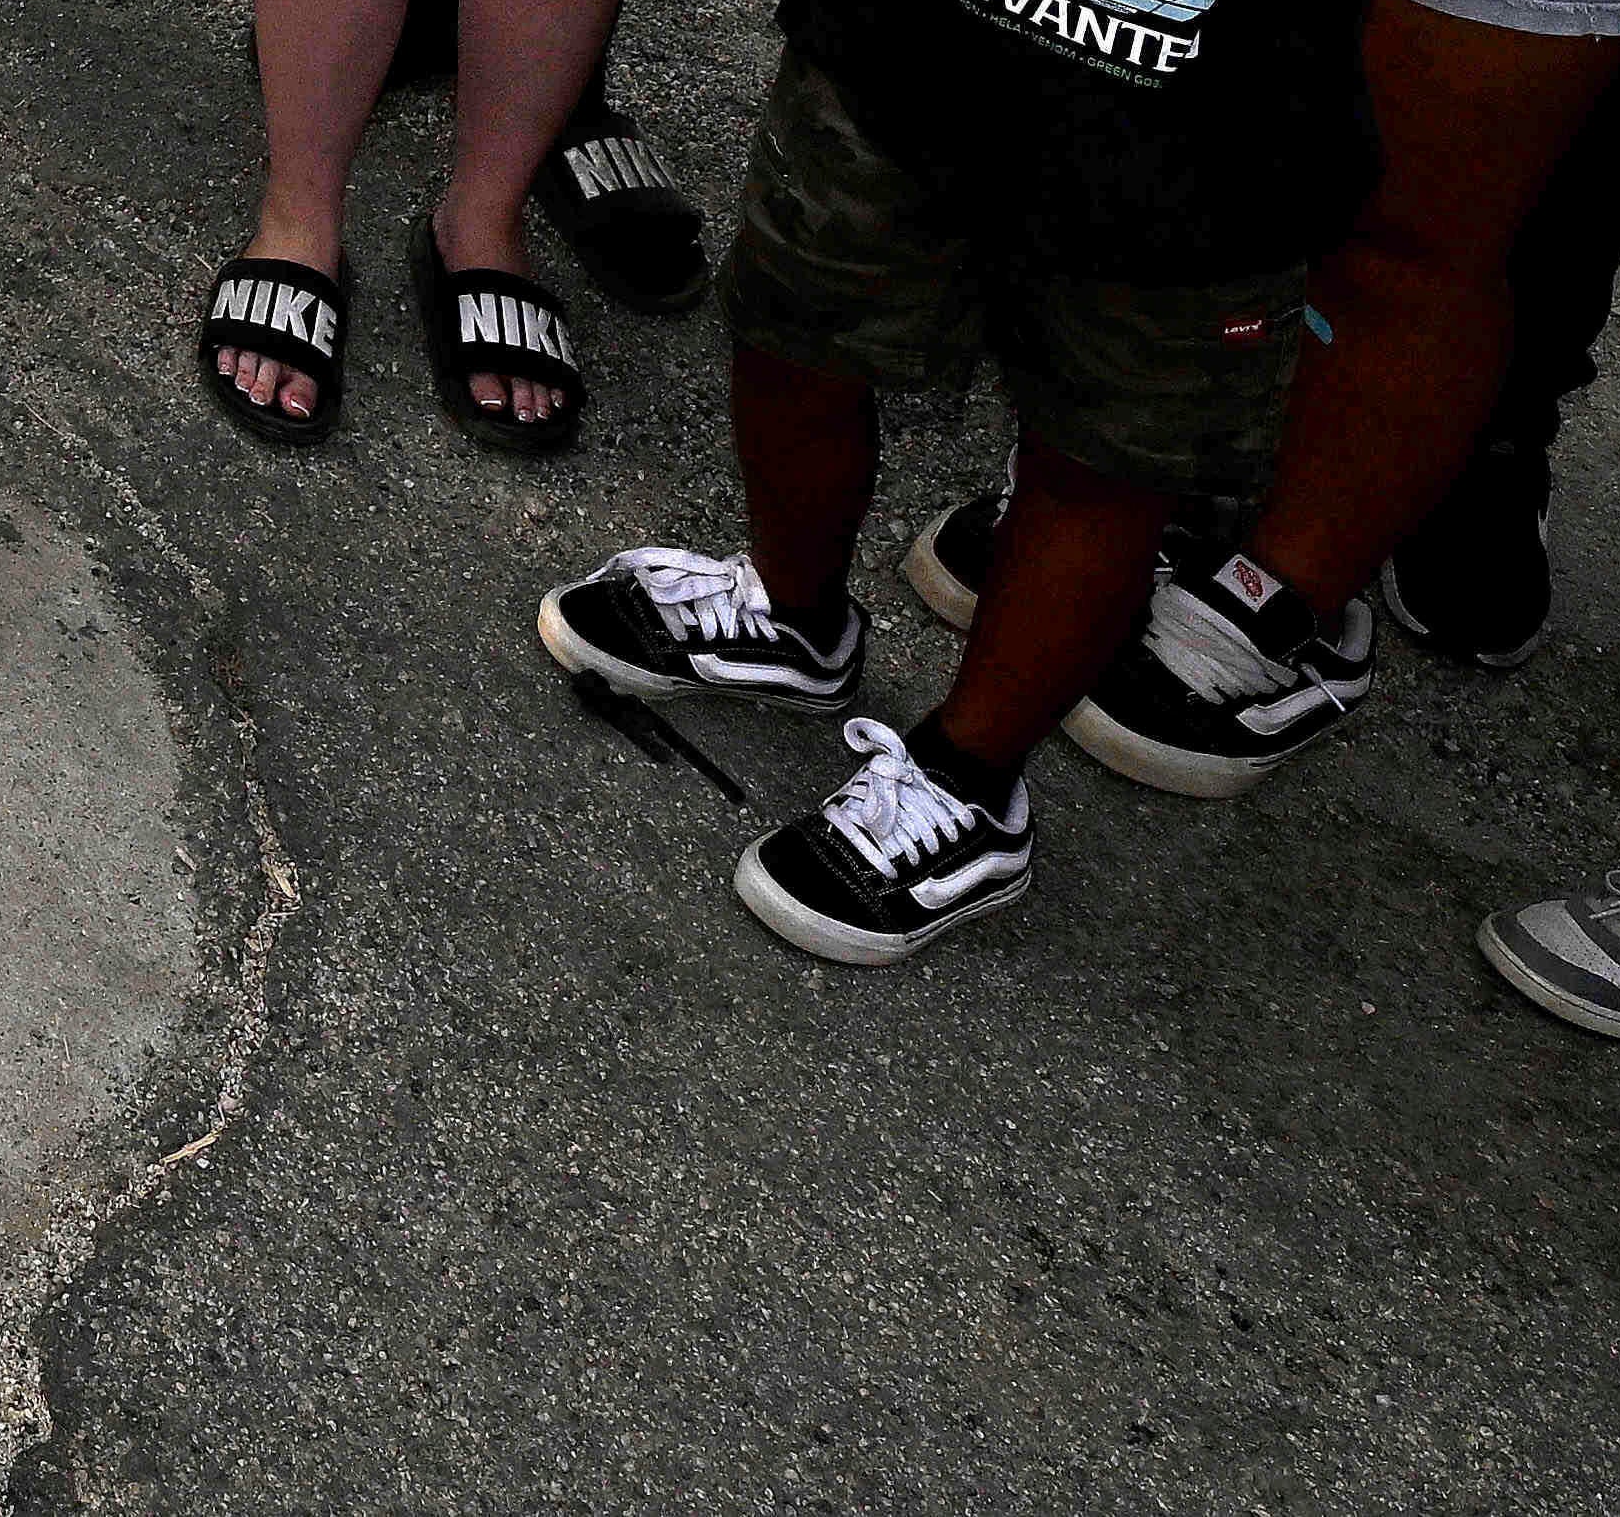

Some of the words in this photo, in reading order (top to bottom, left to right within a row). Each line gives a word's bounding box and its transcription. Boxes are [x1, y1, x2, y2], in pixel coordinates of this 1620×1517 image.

[990, 14, 1021, 33] HELA
[1087, 55, 1131, 82] GREEN
[211, 279, 337, 357] NIKE
